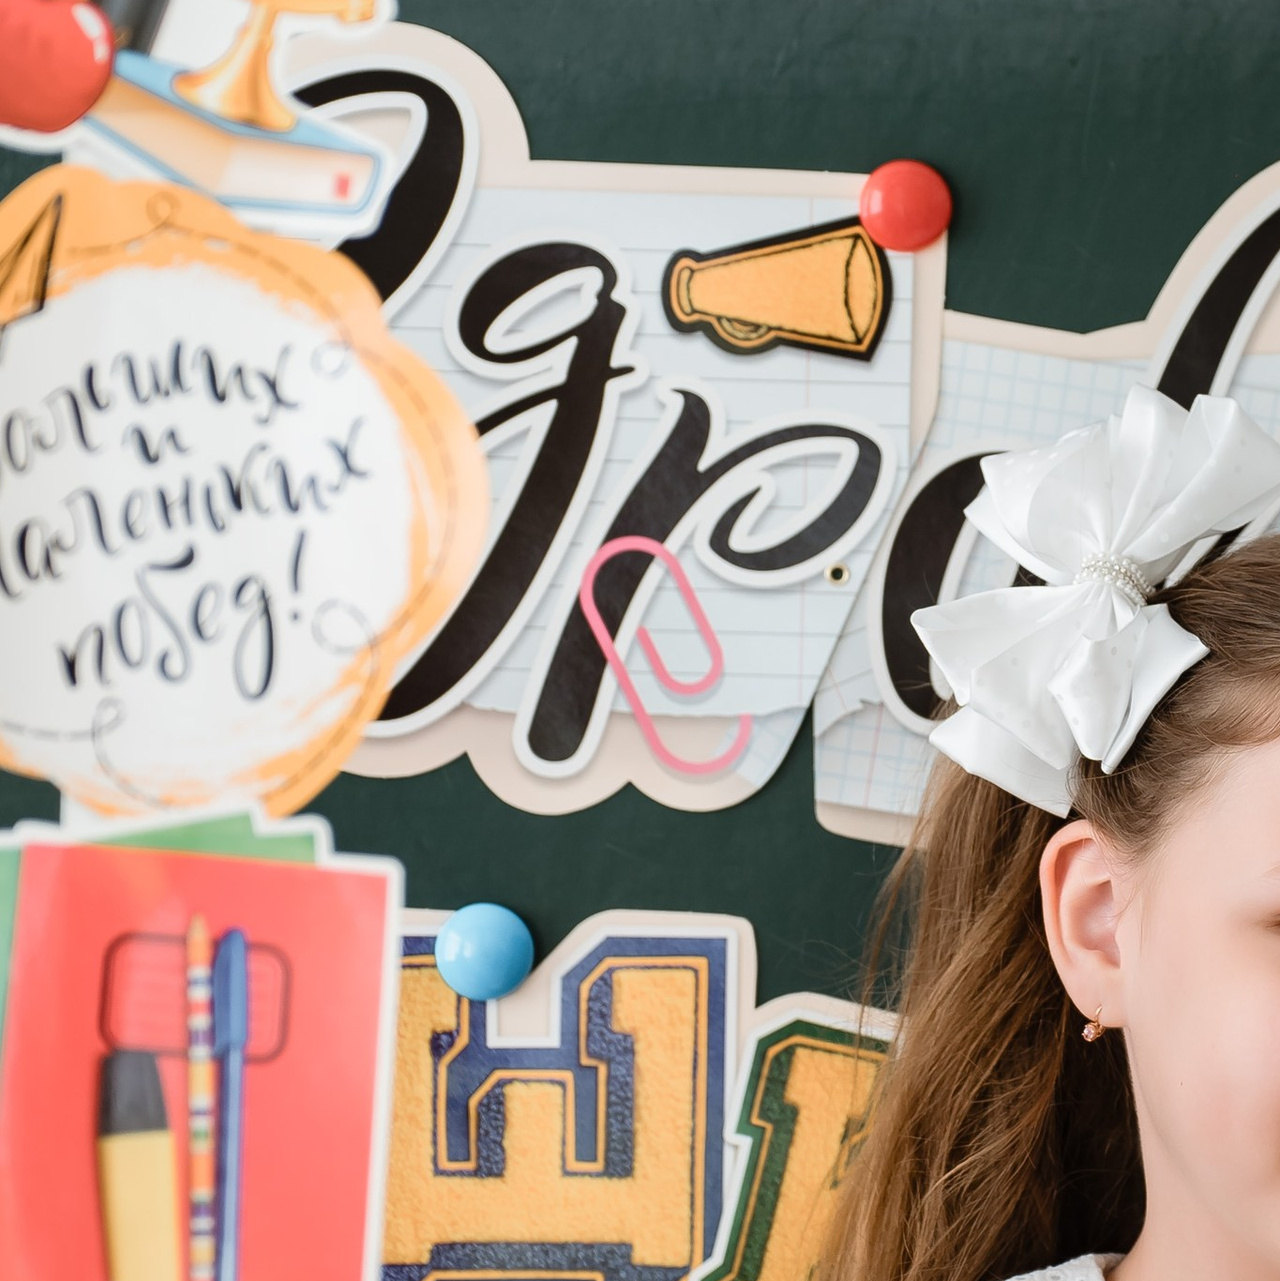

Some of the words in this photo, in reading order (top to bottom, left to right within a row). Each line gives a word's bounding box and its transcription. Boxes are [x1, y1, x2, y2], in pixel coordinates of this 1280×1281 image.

[3, 340, 301, 473] ольших
[121, 425, 191, 465] и
[0, 418, 371, 599] аленьких
[57, 527, 305, 701] побед!
